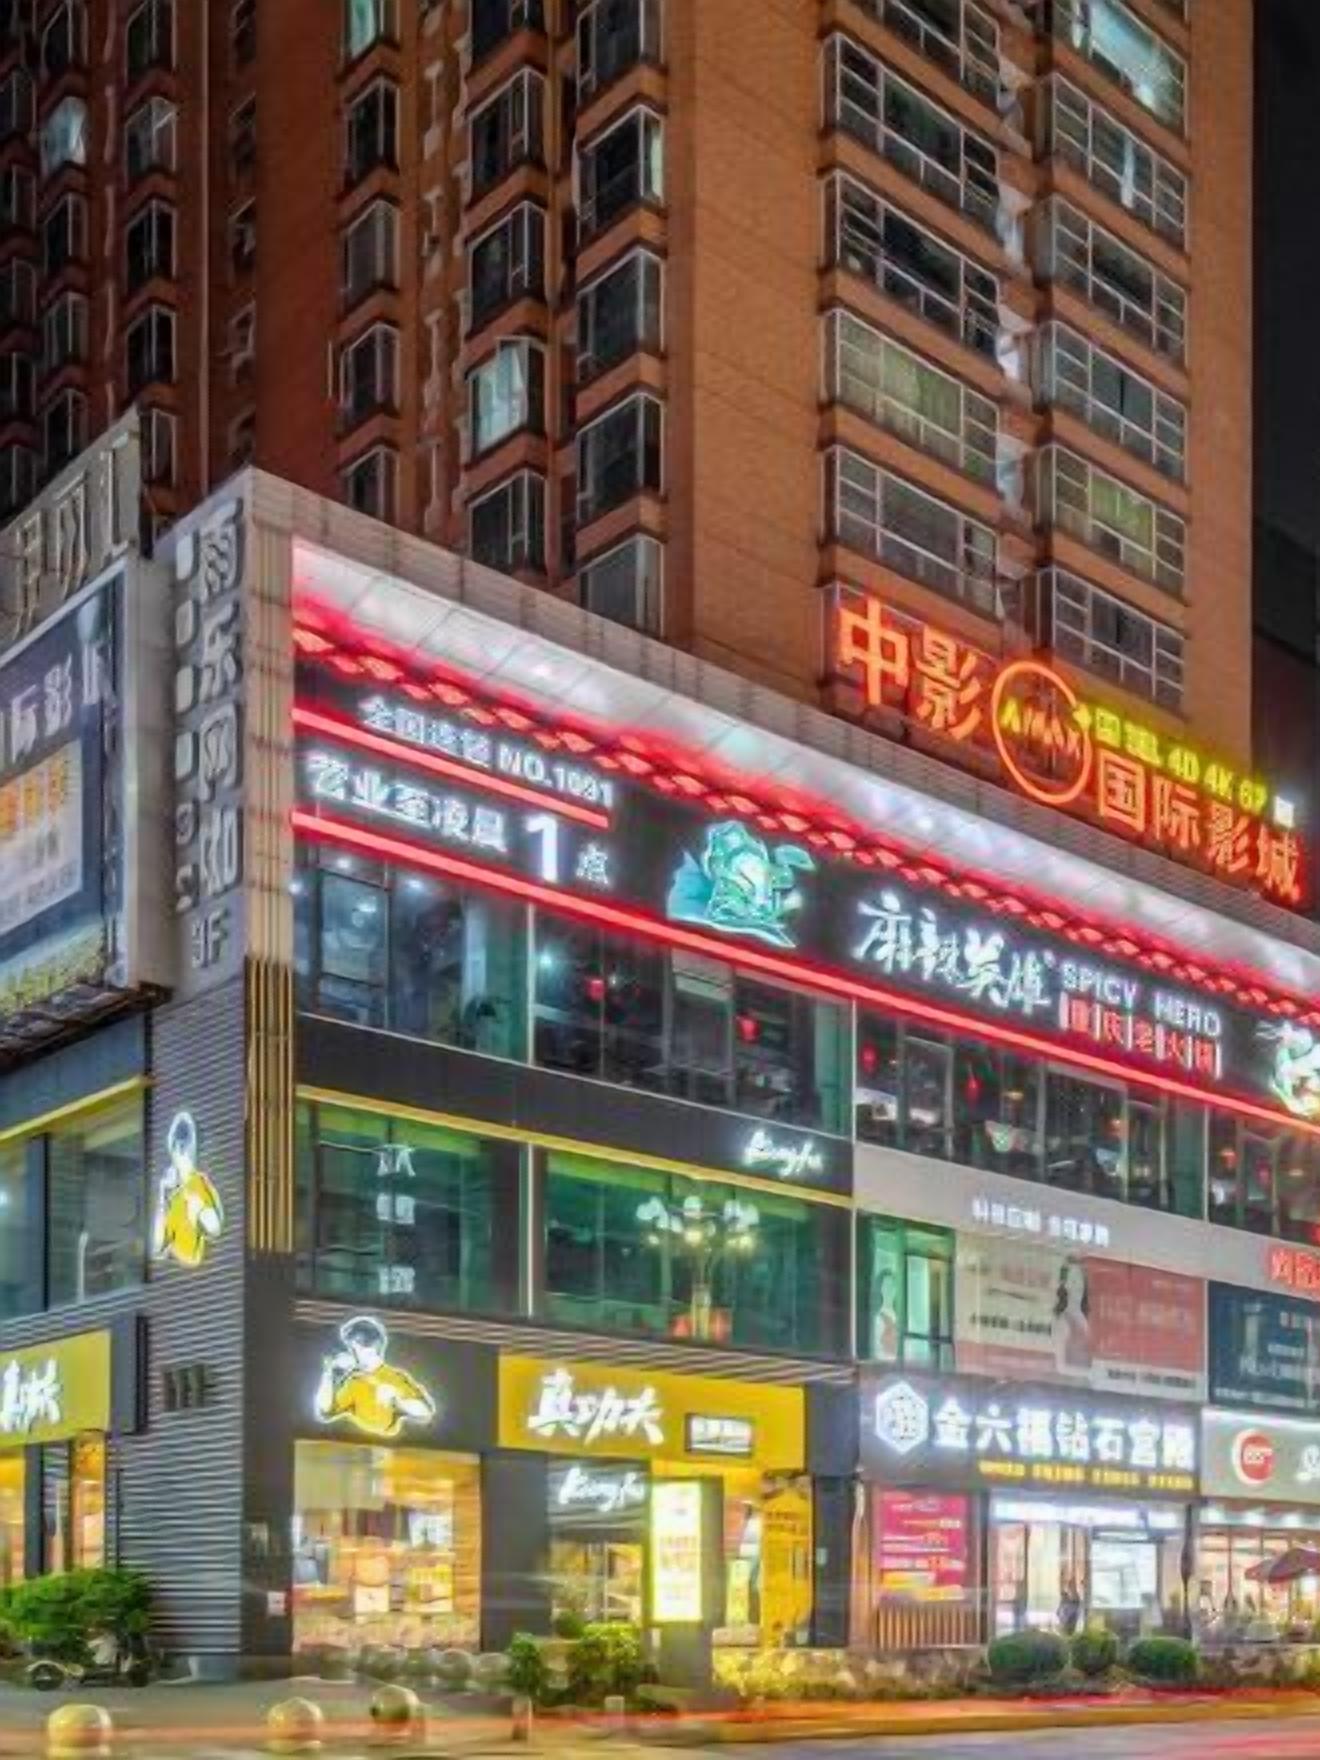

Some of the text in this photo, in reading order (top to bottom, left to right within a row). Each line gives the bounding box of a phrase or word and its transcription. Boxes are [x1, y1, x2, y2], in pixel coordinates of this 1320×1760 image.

[837, 595, 982, 740] 中影
[1099, 749, 1304, 906] 国际影城
[1062, 957, 1138, 1009] SPICY
[528, 1368, 665, 1446] 真功夫
